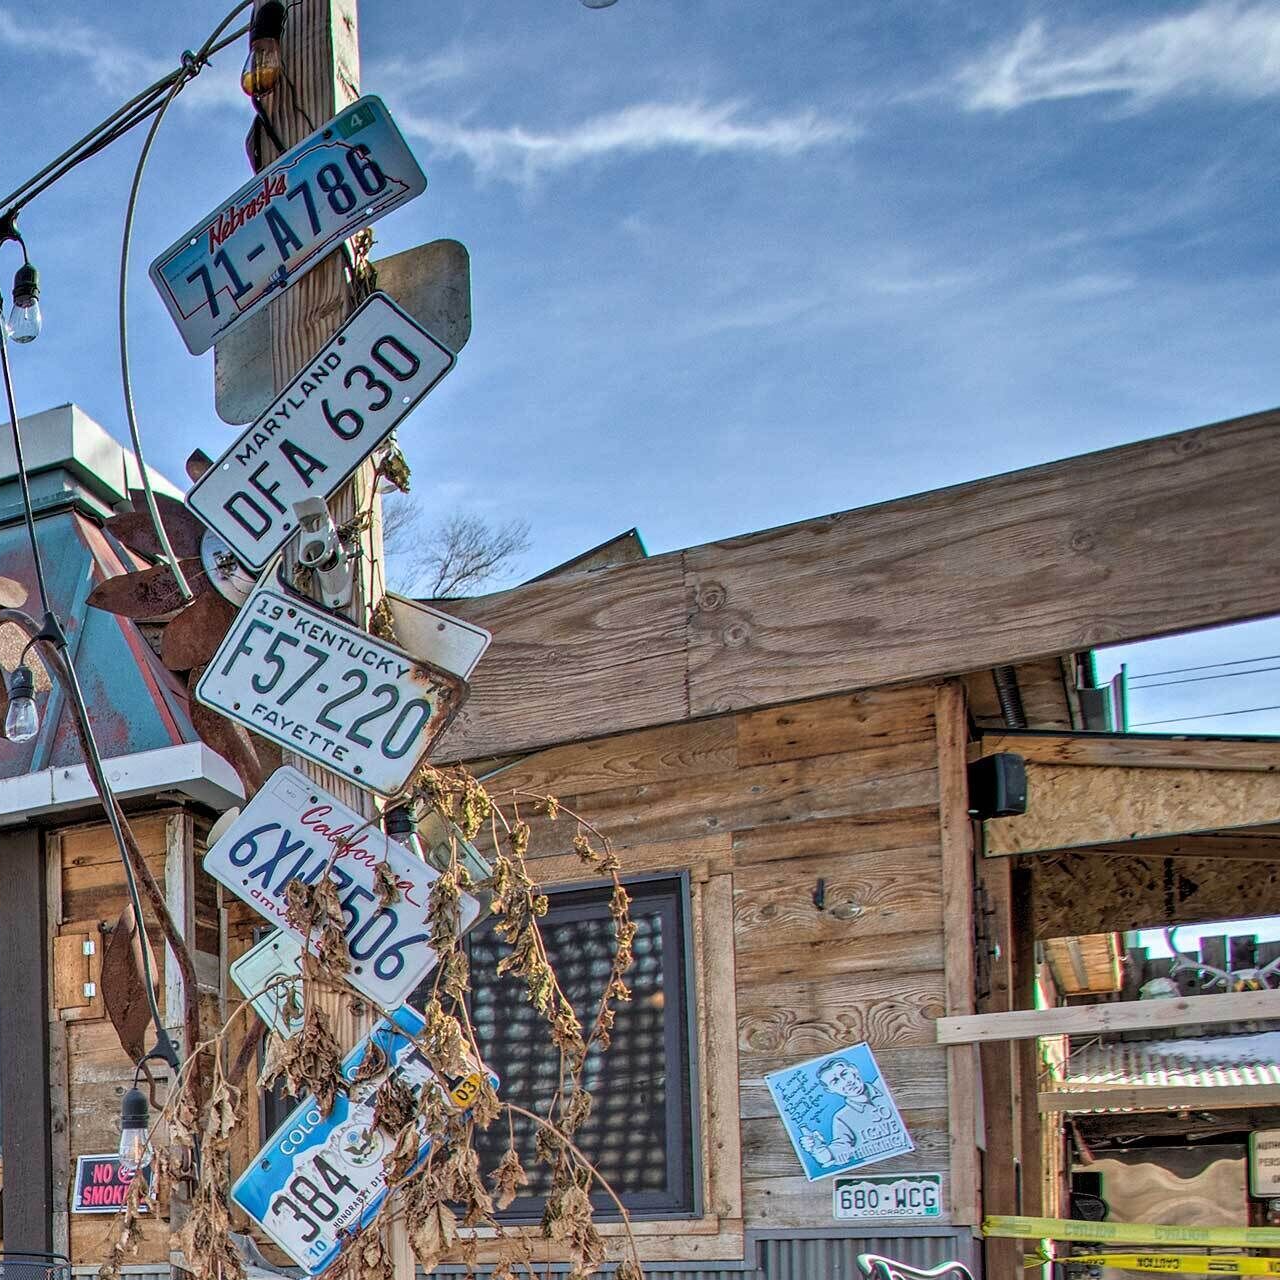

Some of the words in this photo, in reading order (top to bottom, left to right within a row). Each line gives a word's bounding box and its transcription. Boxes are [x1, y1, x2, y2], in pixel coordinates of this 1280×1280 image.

[350, 112, 364, 128] 4
[187, 144, 387, 318] 71-A786
[208, 174, 288, 254] Nebraska
[223, 438, 328, 542] DFA
[321, 335, 421, 441] 630
[235, 352, 342, 467] MARYLAND
[294, 619, 411, 680] KENTUCKY
[251, 703, 350, 762] FAYETTE
[455, 1080, 478, 1101] 03
[93, 1163, 113, 1183] NO
[272, 1155, 360, 1243] 384
[862, 1208, 914, 1216] COLORADO
